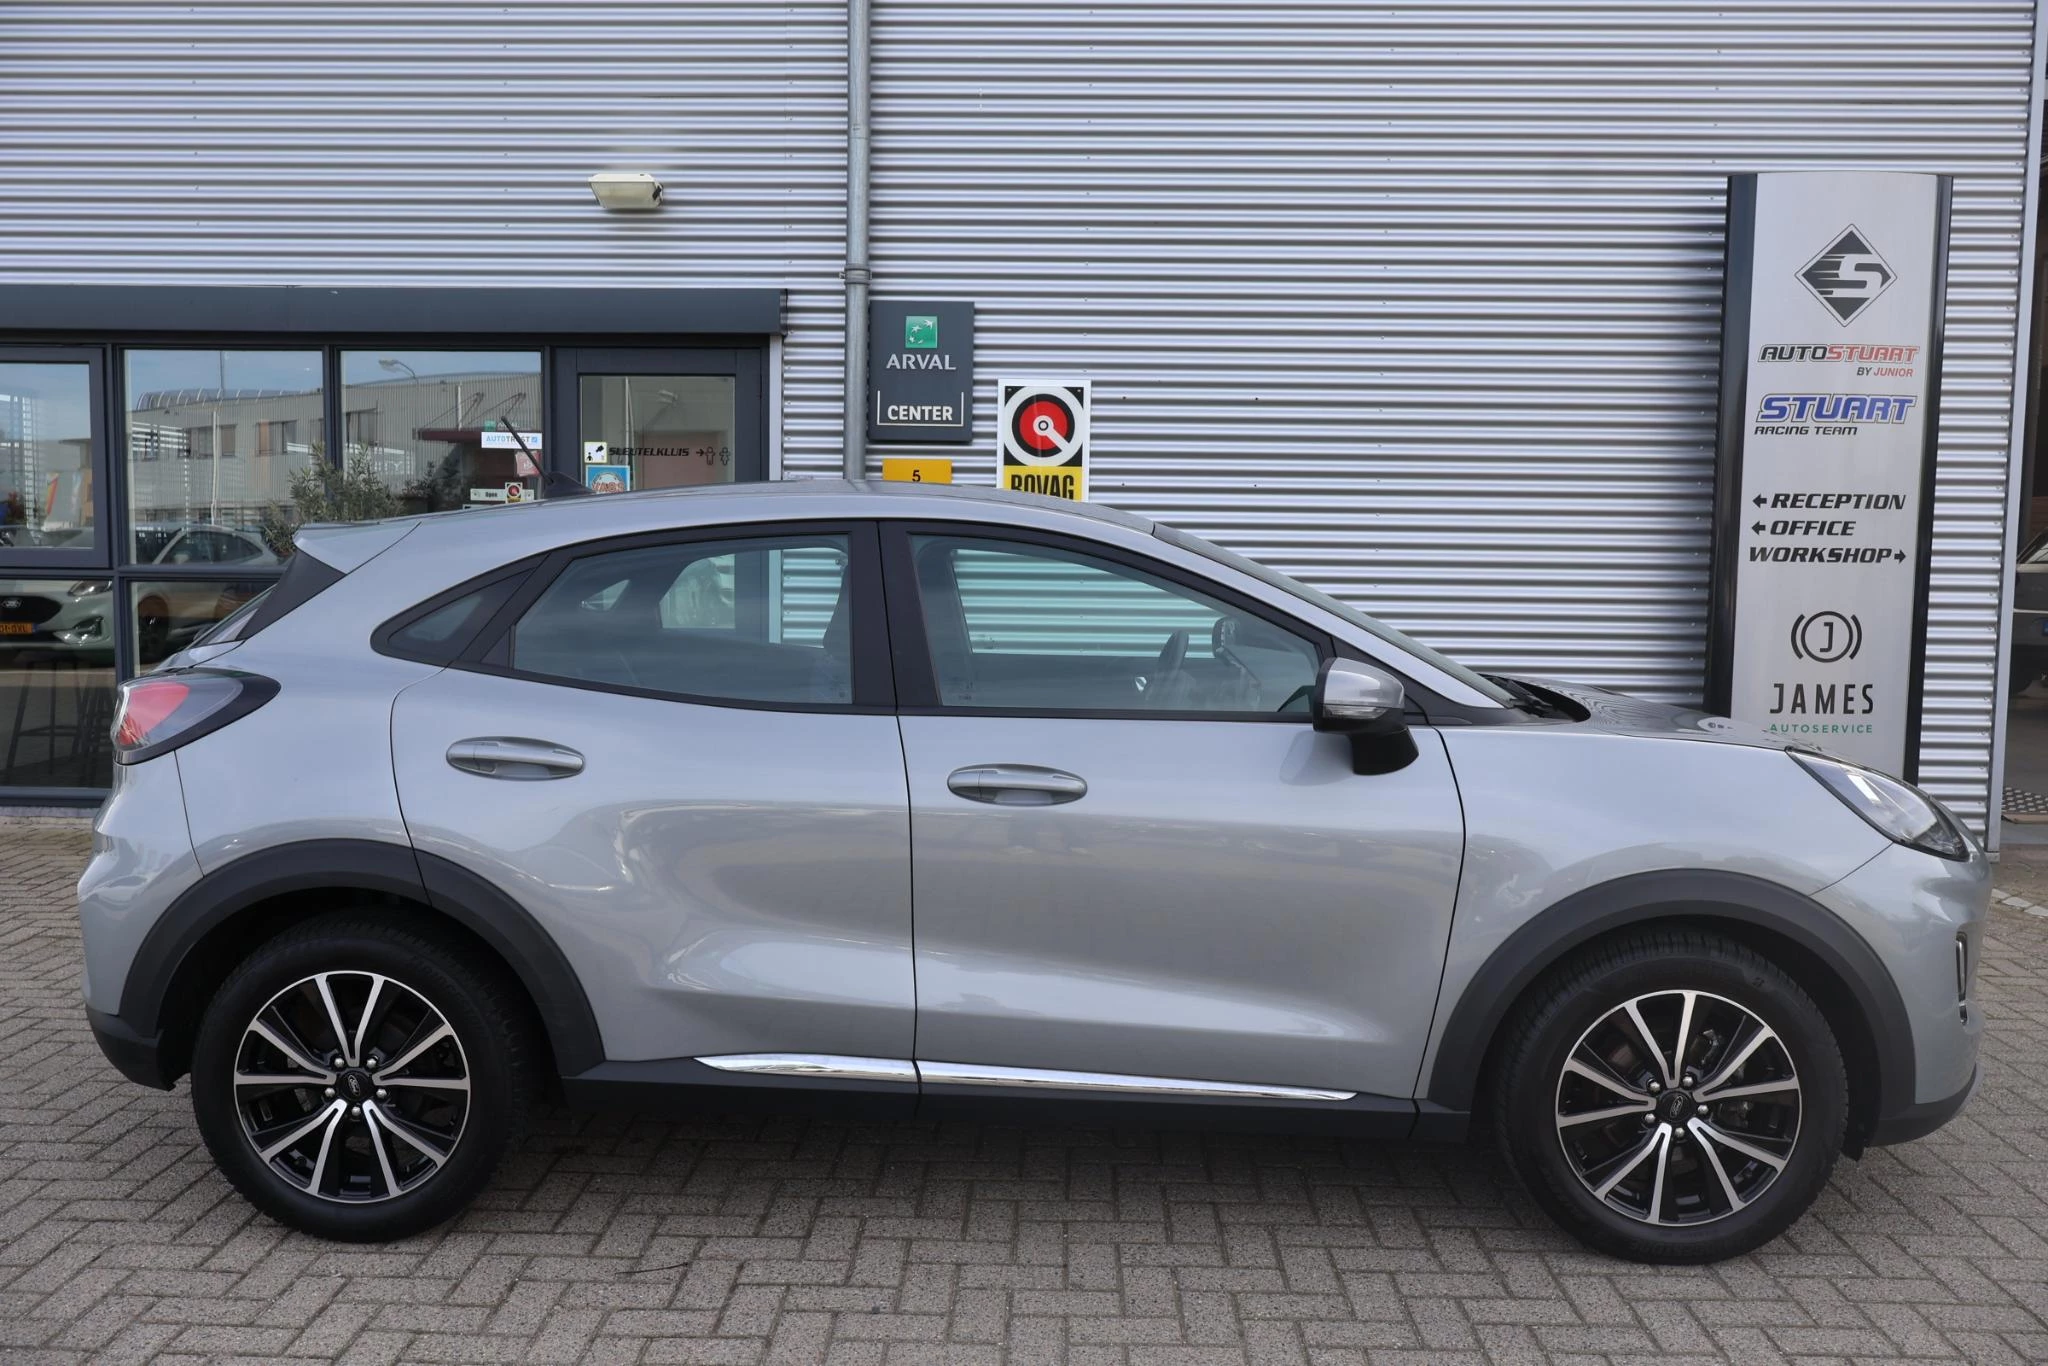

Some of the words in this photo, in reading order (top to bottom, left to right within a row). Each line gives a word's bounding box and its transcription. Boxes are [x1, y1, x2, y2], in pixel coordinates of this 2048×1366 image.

[886, 353, 956, 370] ARVAL
[1759, 345, 1919, 363] AUTOSTUART
[1856, 367, 1872, 376] BY
[1873, 367, 1913, 377] JUNIOR
[887, 405, 953, 421] CENTER
[1758, 395, 1916, 423] STUART
[1754, 426, 1809, 435] RACING
[1815, 426, 1858, 435] TEAM
[608, 447, 690, 457] SLEUTELKLUIS
[911, 469, 922, 483] 5
[1770, 493, 1906, 510] RECEPTION
[1770, 520, 1856, 536] OFFICE
[1748, 546, 1892, 563] WORKSHOP
[1769, 683, 1874, 715] JAMES
[1769, 723, 1873, 734] AUTOSERVICE
